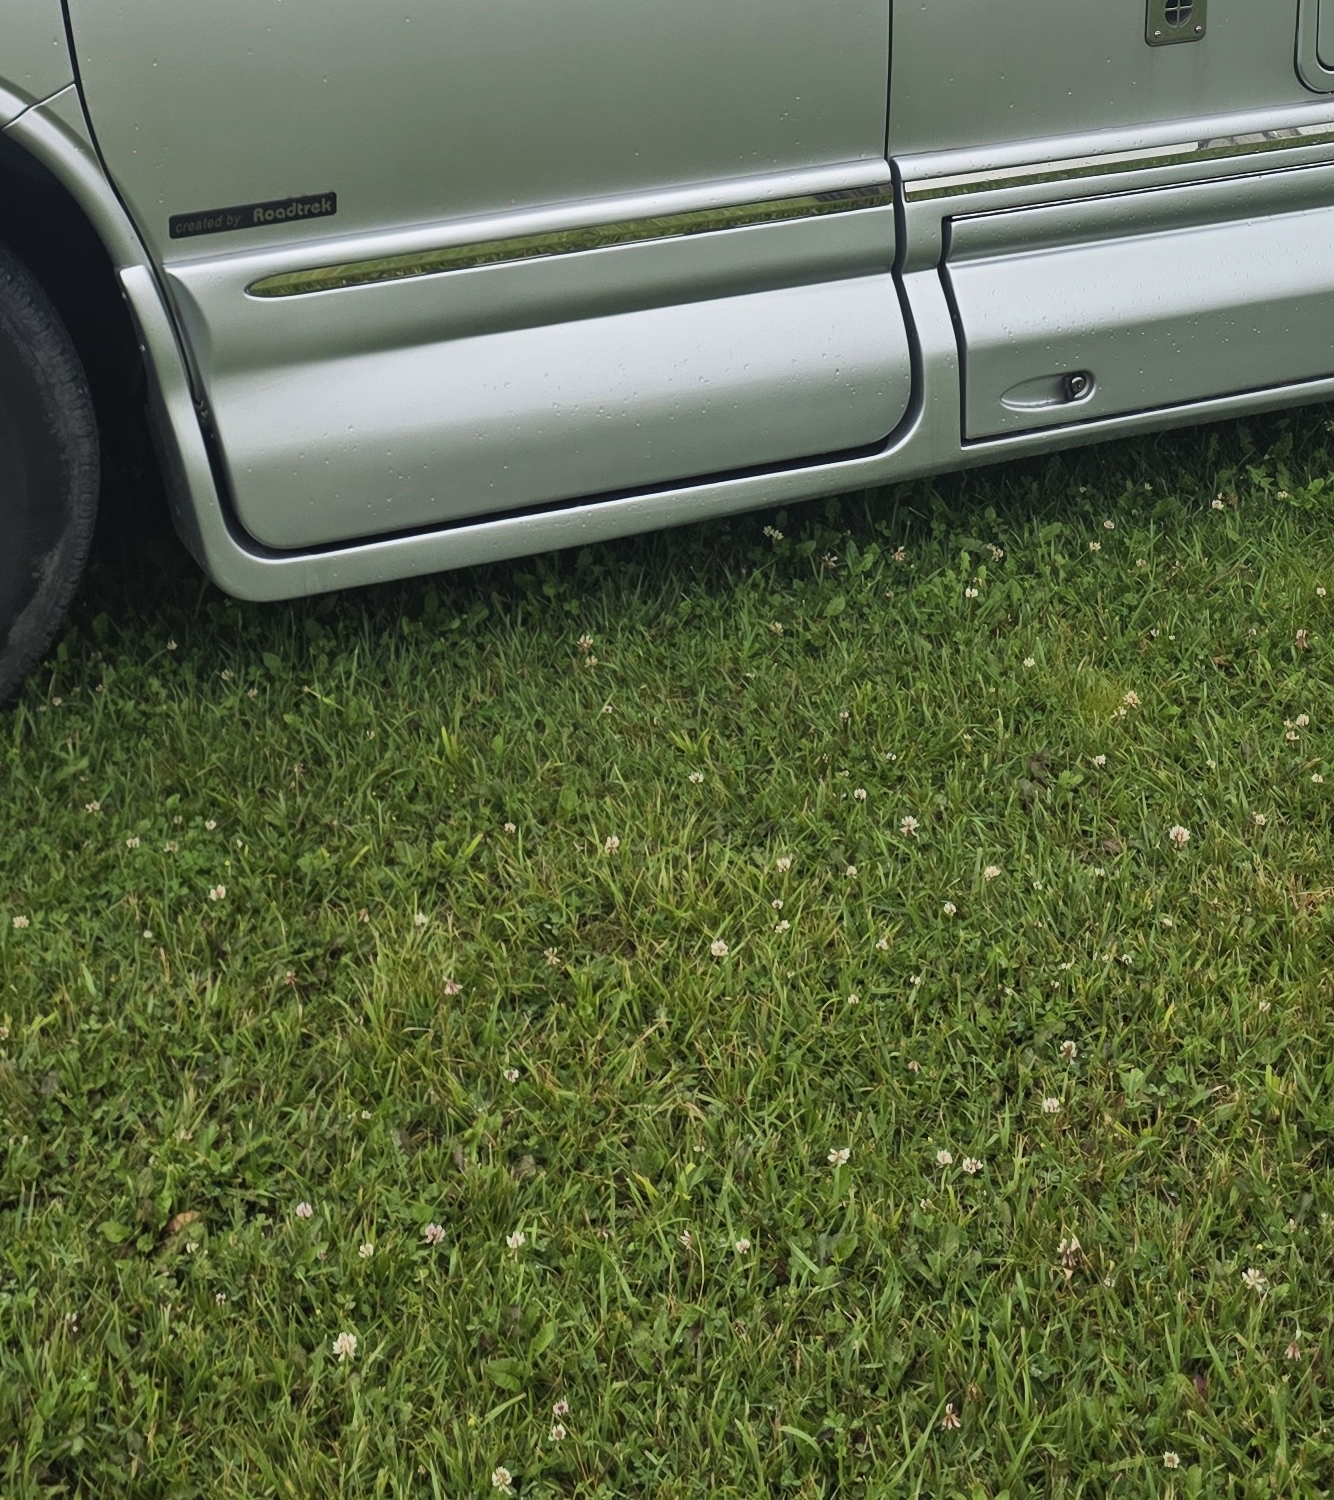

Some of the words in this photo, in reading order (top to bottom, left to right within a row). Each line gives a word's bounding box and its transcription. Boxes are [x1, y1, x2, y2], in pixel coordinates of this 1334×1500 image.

[175, 213, 223, 234] created
[226, 213, 242, 228] by
[253, 197, 332, 223] Roadtrek
